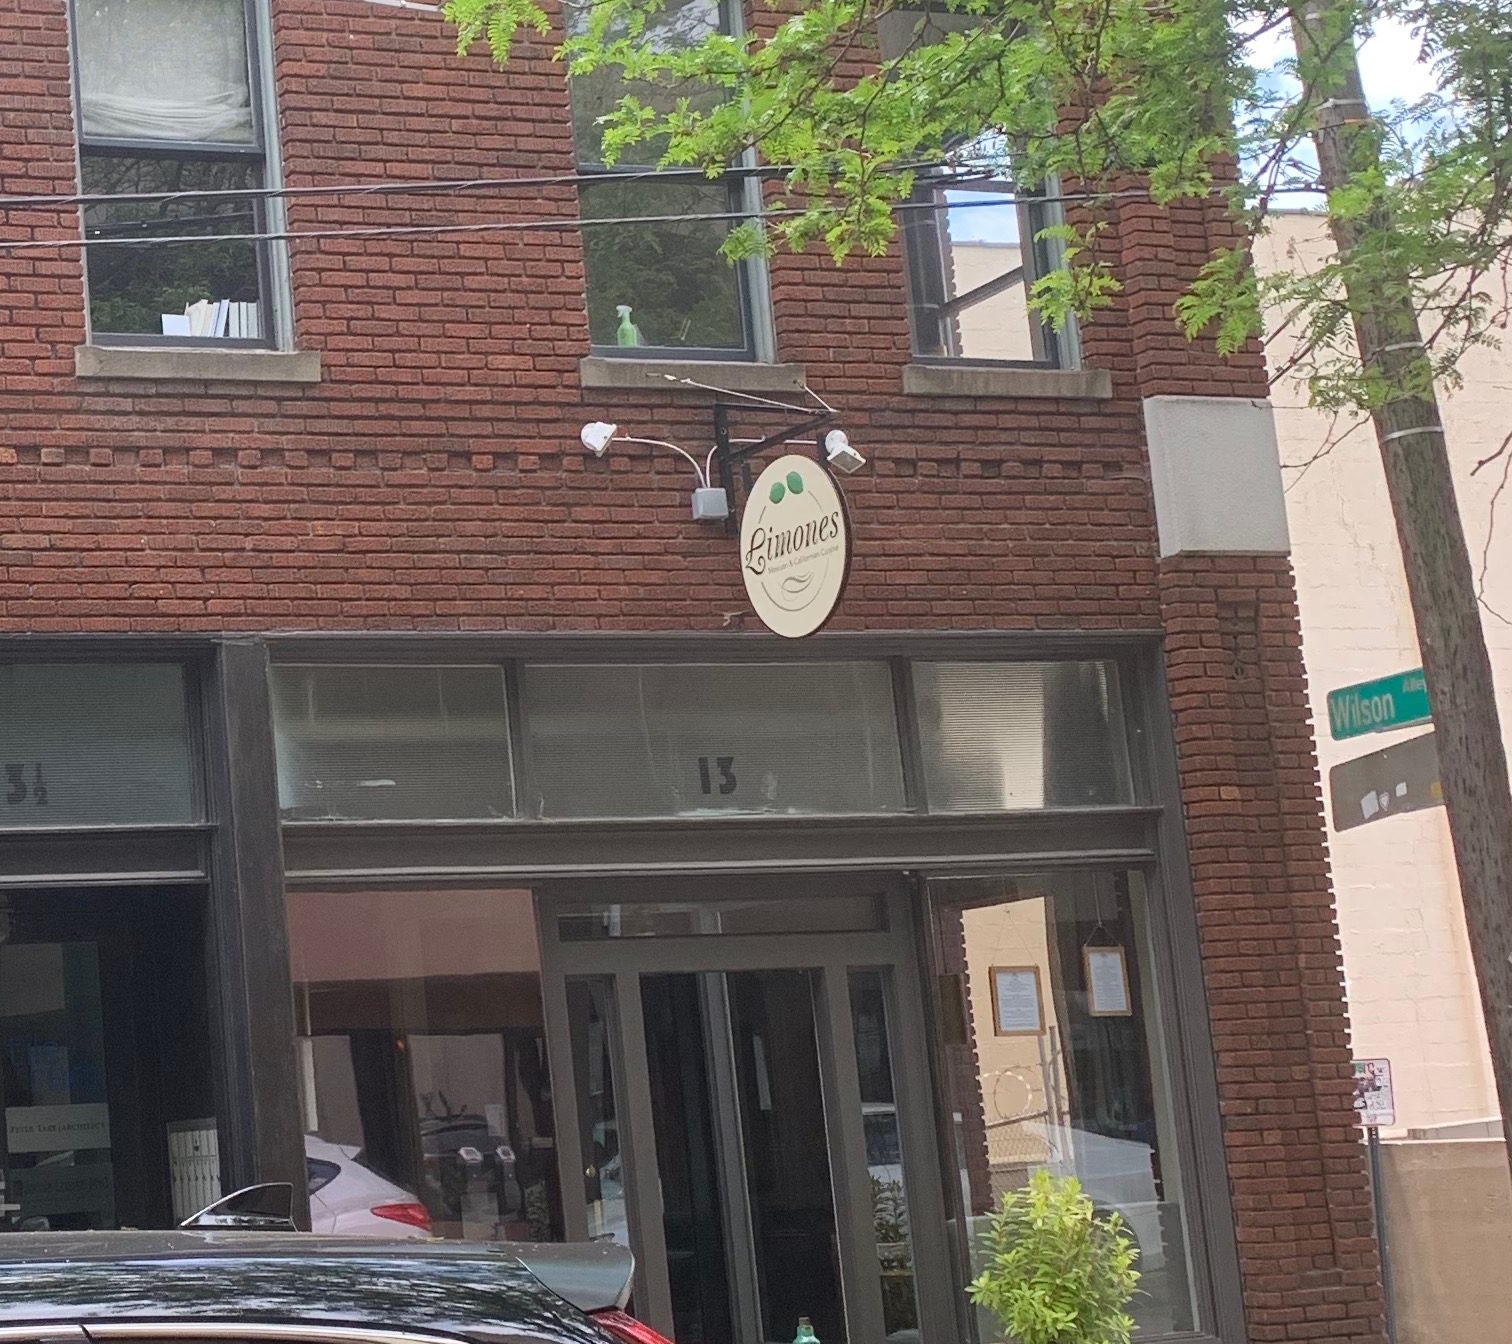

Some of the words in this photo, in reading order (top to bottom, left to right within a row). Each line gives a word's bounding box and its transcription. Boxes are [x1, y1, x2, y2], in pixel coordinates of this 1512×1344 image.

[745, 511, 839, 575] Limones
[1330, 693, 1395, 731] Wilson
[698, 756, 737, 794] 13
